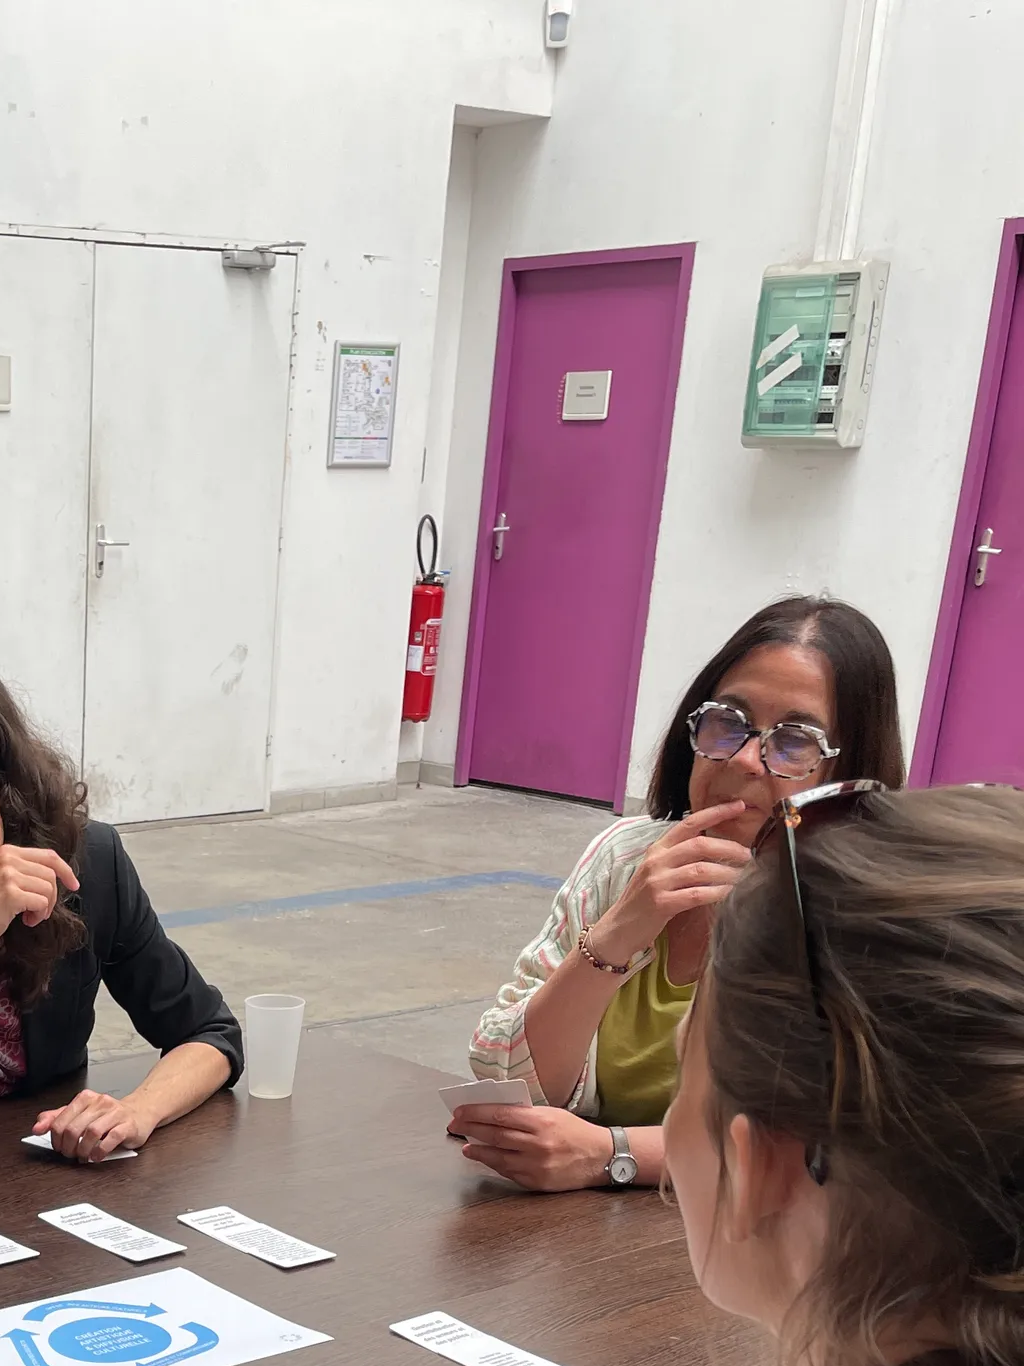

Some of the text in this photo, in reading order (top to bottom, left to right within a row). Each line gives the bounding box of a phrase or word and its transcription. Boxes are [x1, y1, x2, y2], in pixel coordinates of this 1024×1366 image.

[74, 1325, 122, 1341] CRÉATION
[79, 1329, 134, 1347] ARTISTIQUE
[93, 1333, 144, 1349] DIFFUSION
[92, 1338, 153, 1356] CULTURELLE
